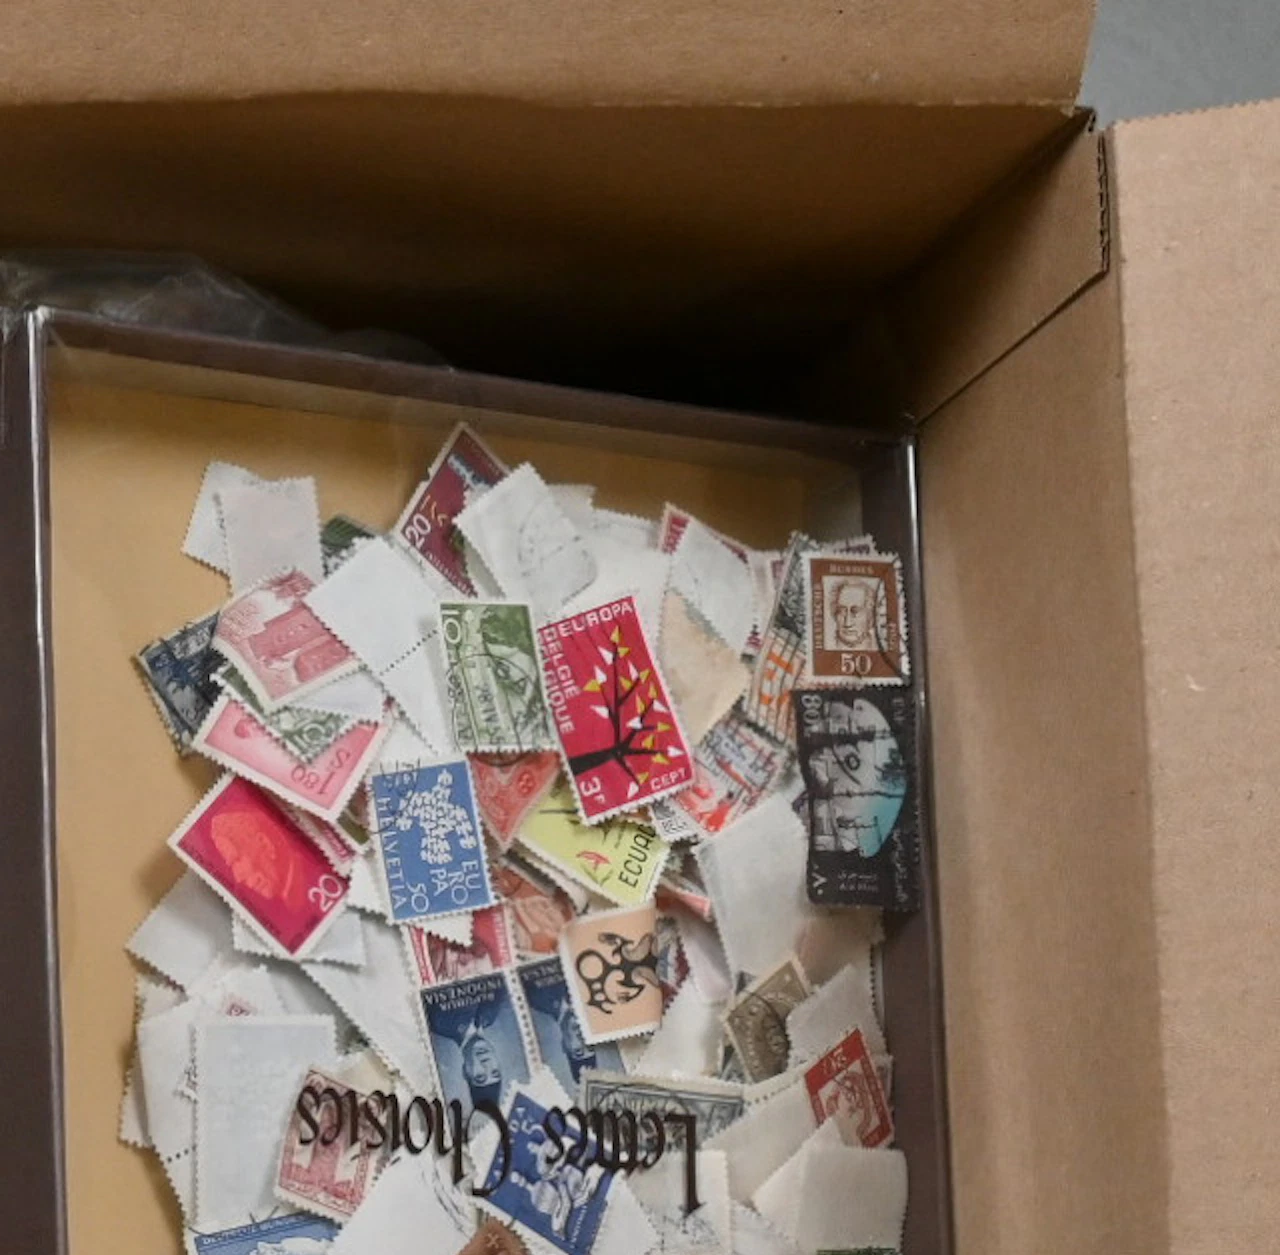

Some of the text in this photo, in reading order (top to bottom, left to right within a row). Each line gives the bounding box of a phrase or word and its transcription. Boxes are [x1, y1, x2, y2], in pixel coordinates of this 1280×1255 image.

[404, 513, 432, 549] 20
[441, 610, 461, 644] 10
[558, 602, 634, 638] EUROPA
[840, 653, 873, 676] 50
[376, 796, 408, 910] HELVETIA
[617, 825, 657, 888] ECUAD
[307, 874, 344, 913] 20
[406, 881, 431, 912] 50
[424, 978, 504, 1005] INDONESIA
[297, 1084, 511, 1196] Choisies
